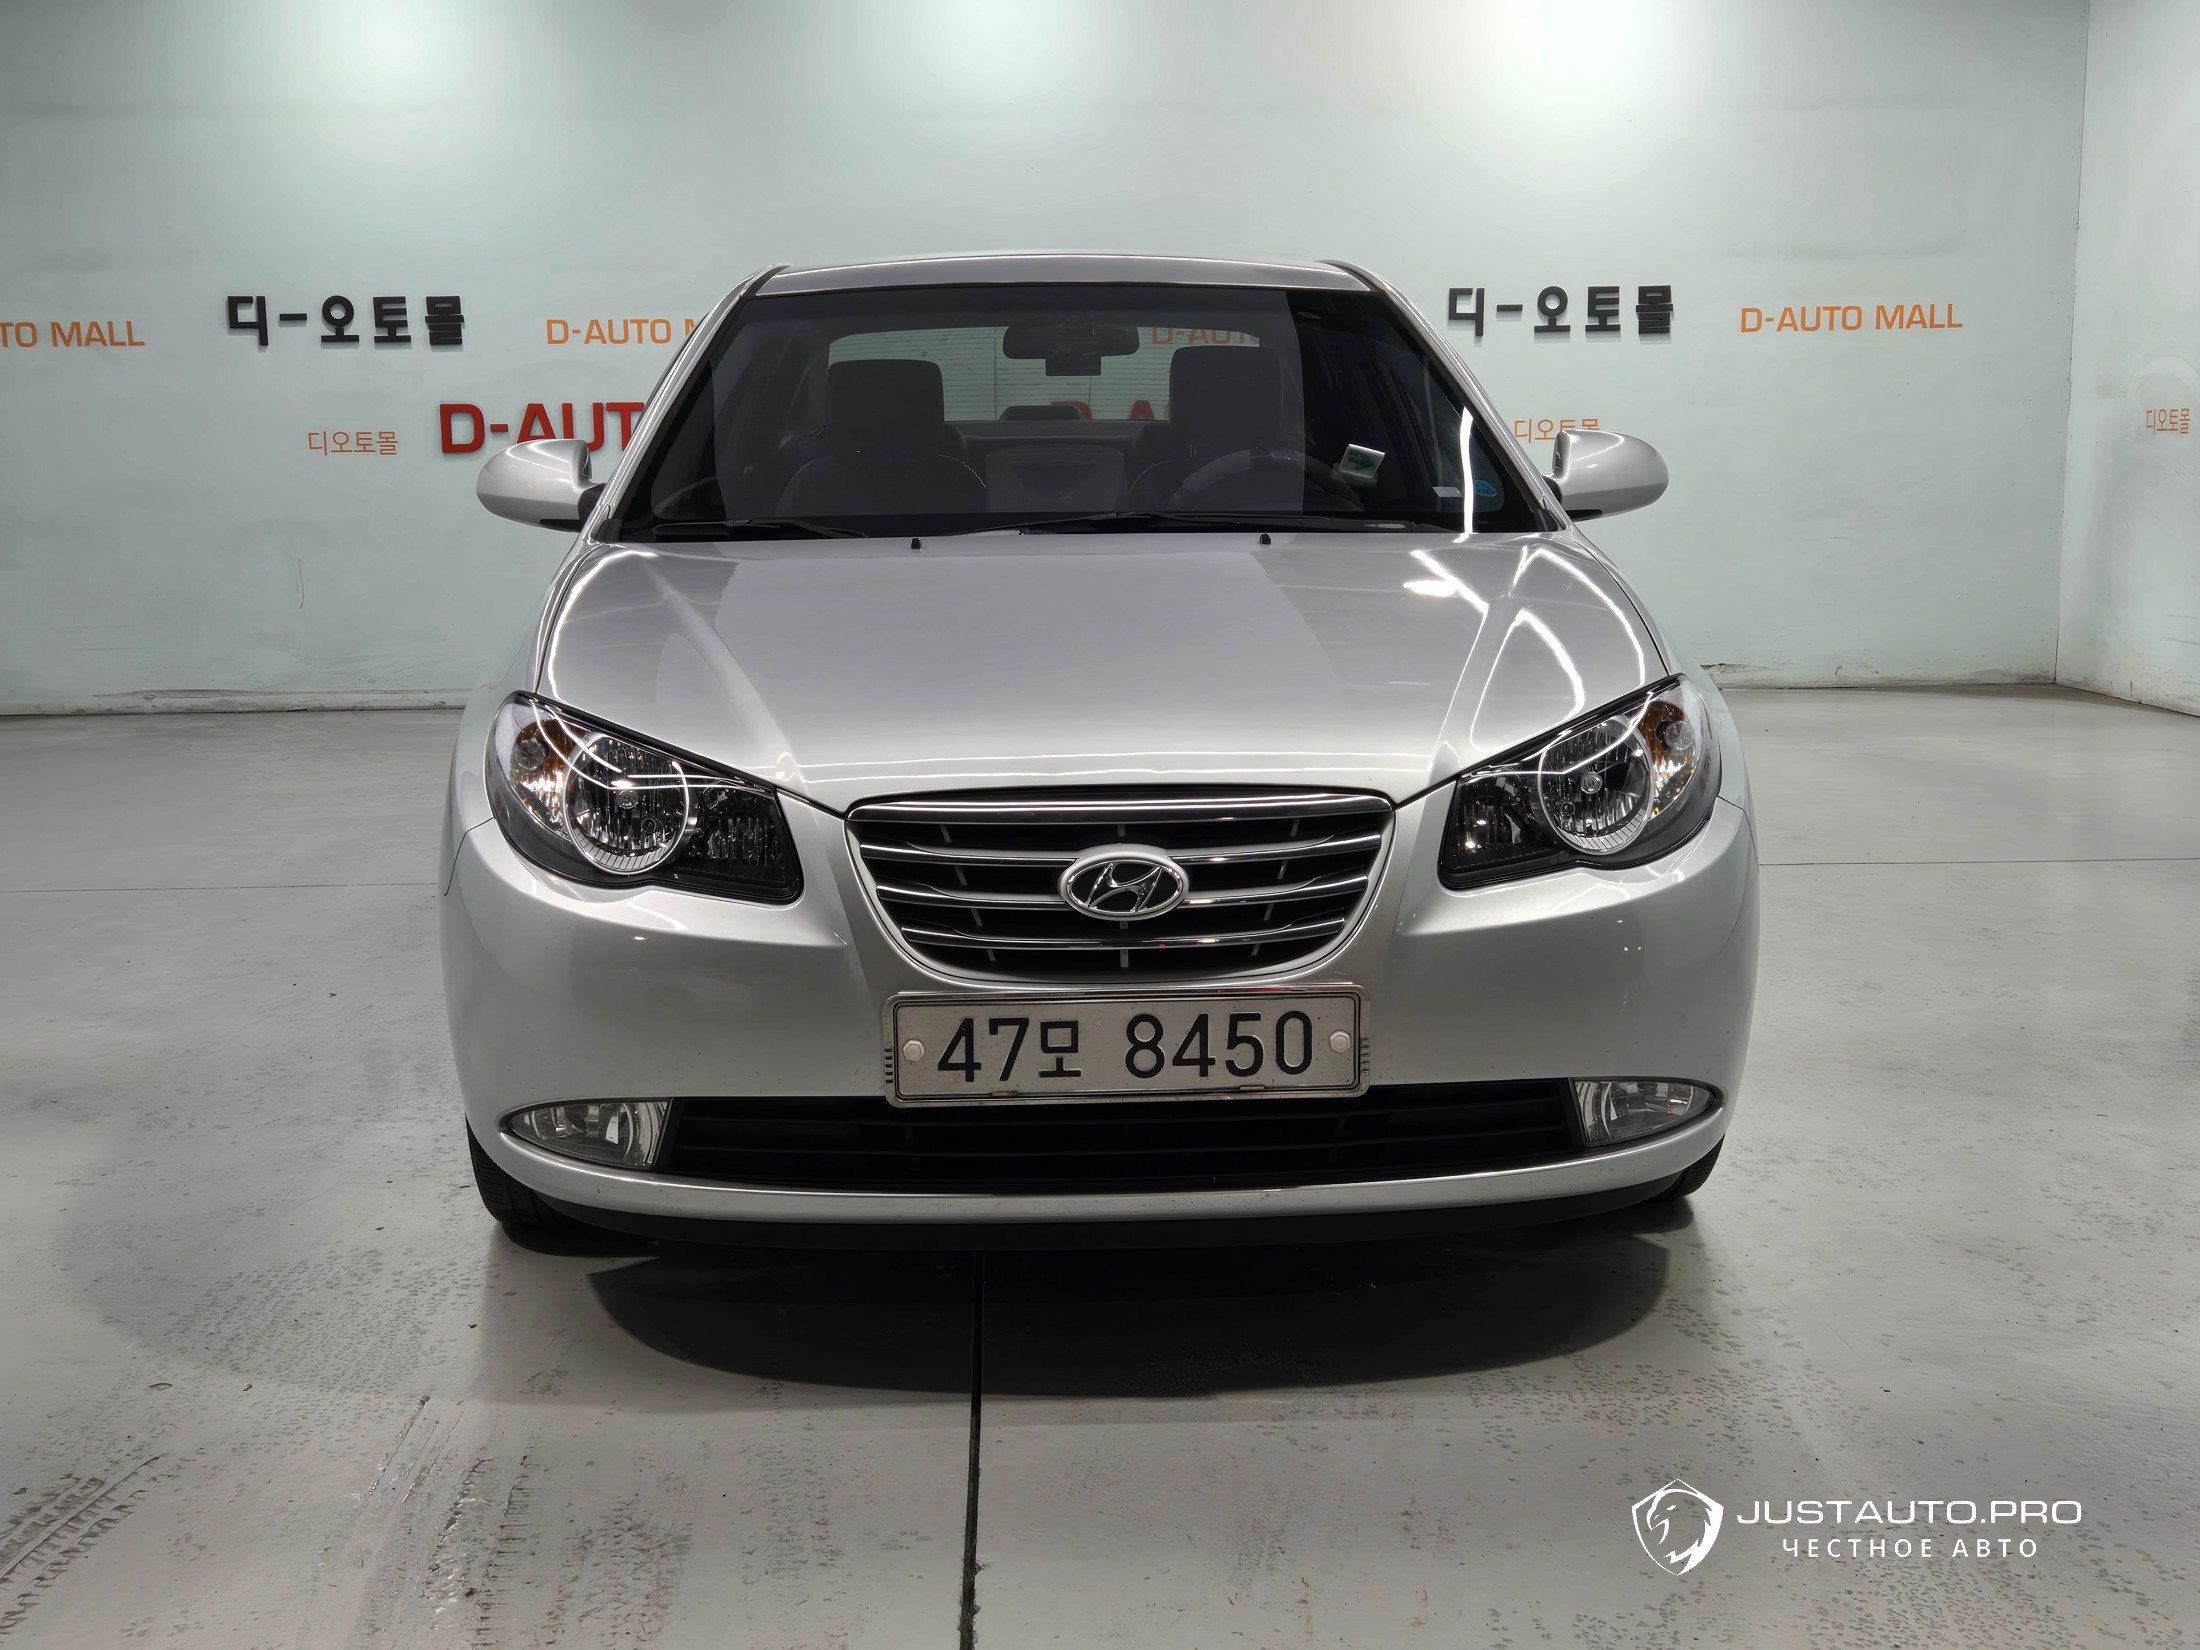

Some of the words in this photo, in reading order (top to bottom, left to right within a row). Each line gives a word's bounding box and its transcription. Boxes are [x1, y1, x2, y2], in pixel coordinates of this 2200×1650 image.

[546, 318, 673, 345] D-AUTO
[1740, 305, 1864, 334] D-AUTO
[1875, 303, 1965, 331] MALL
[50, 320, 146, 348] MALL
[2146, 407, 2191, 435] 디오토몰
[308, 431, 399, 456] 디오토몰
[937, 1017, 1083, 1083] 47모
[1125, 1010, 1313, 1079] 8450
